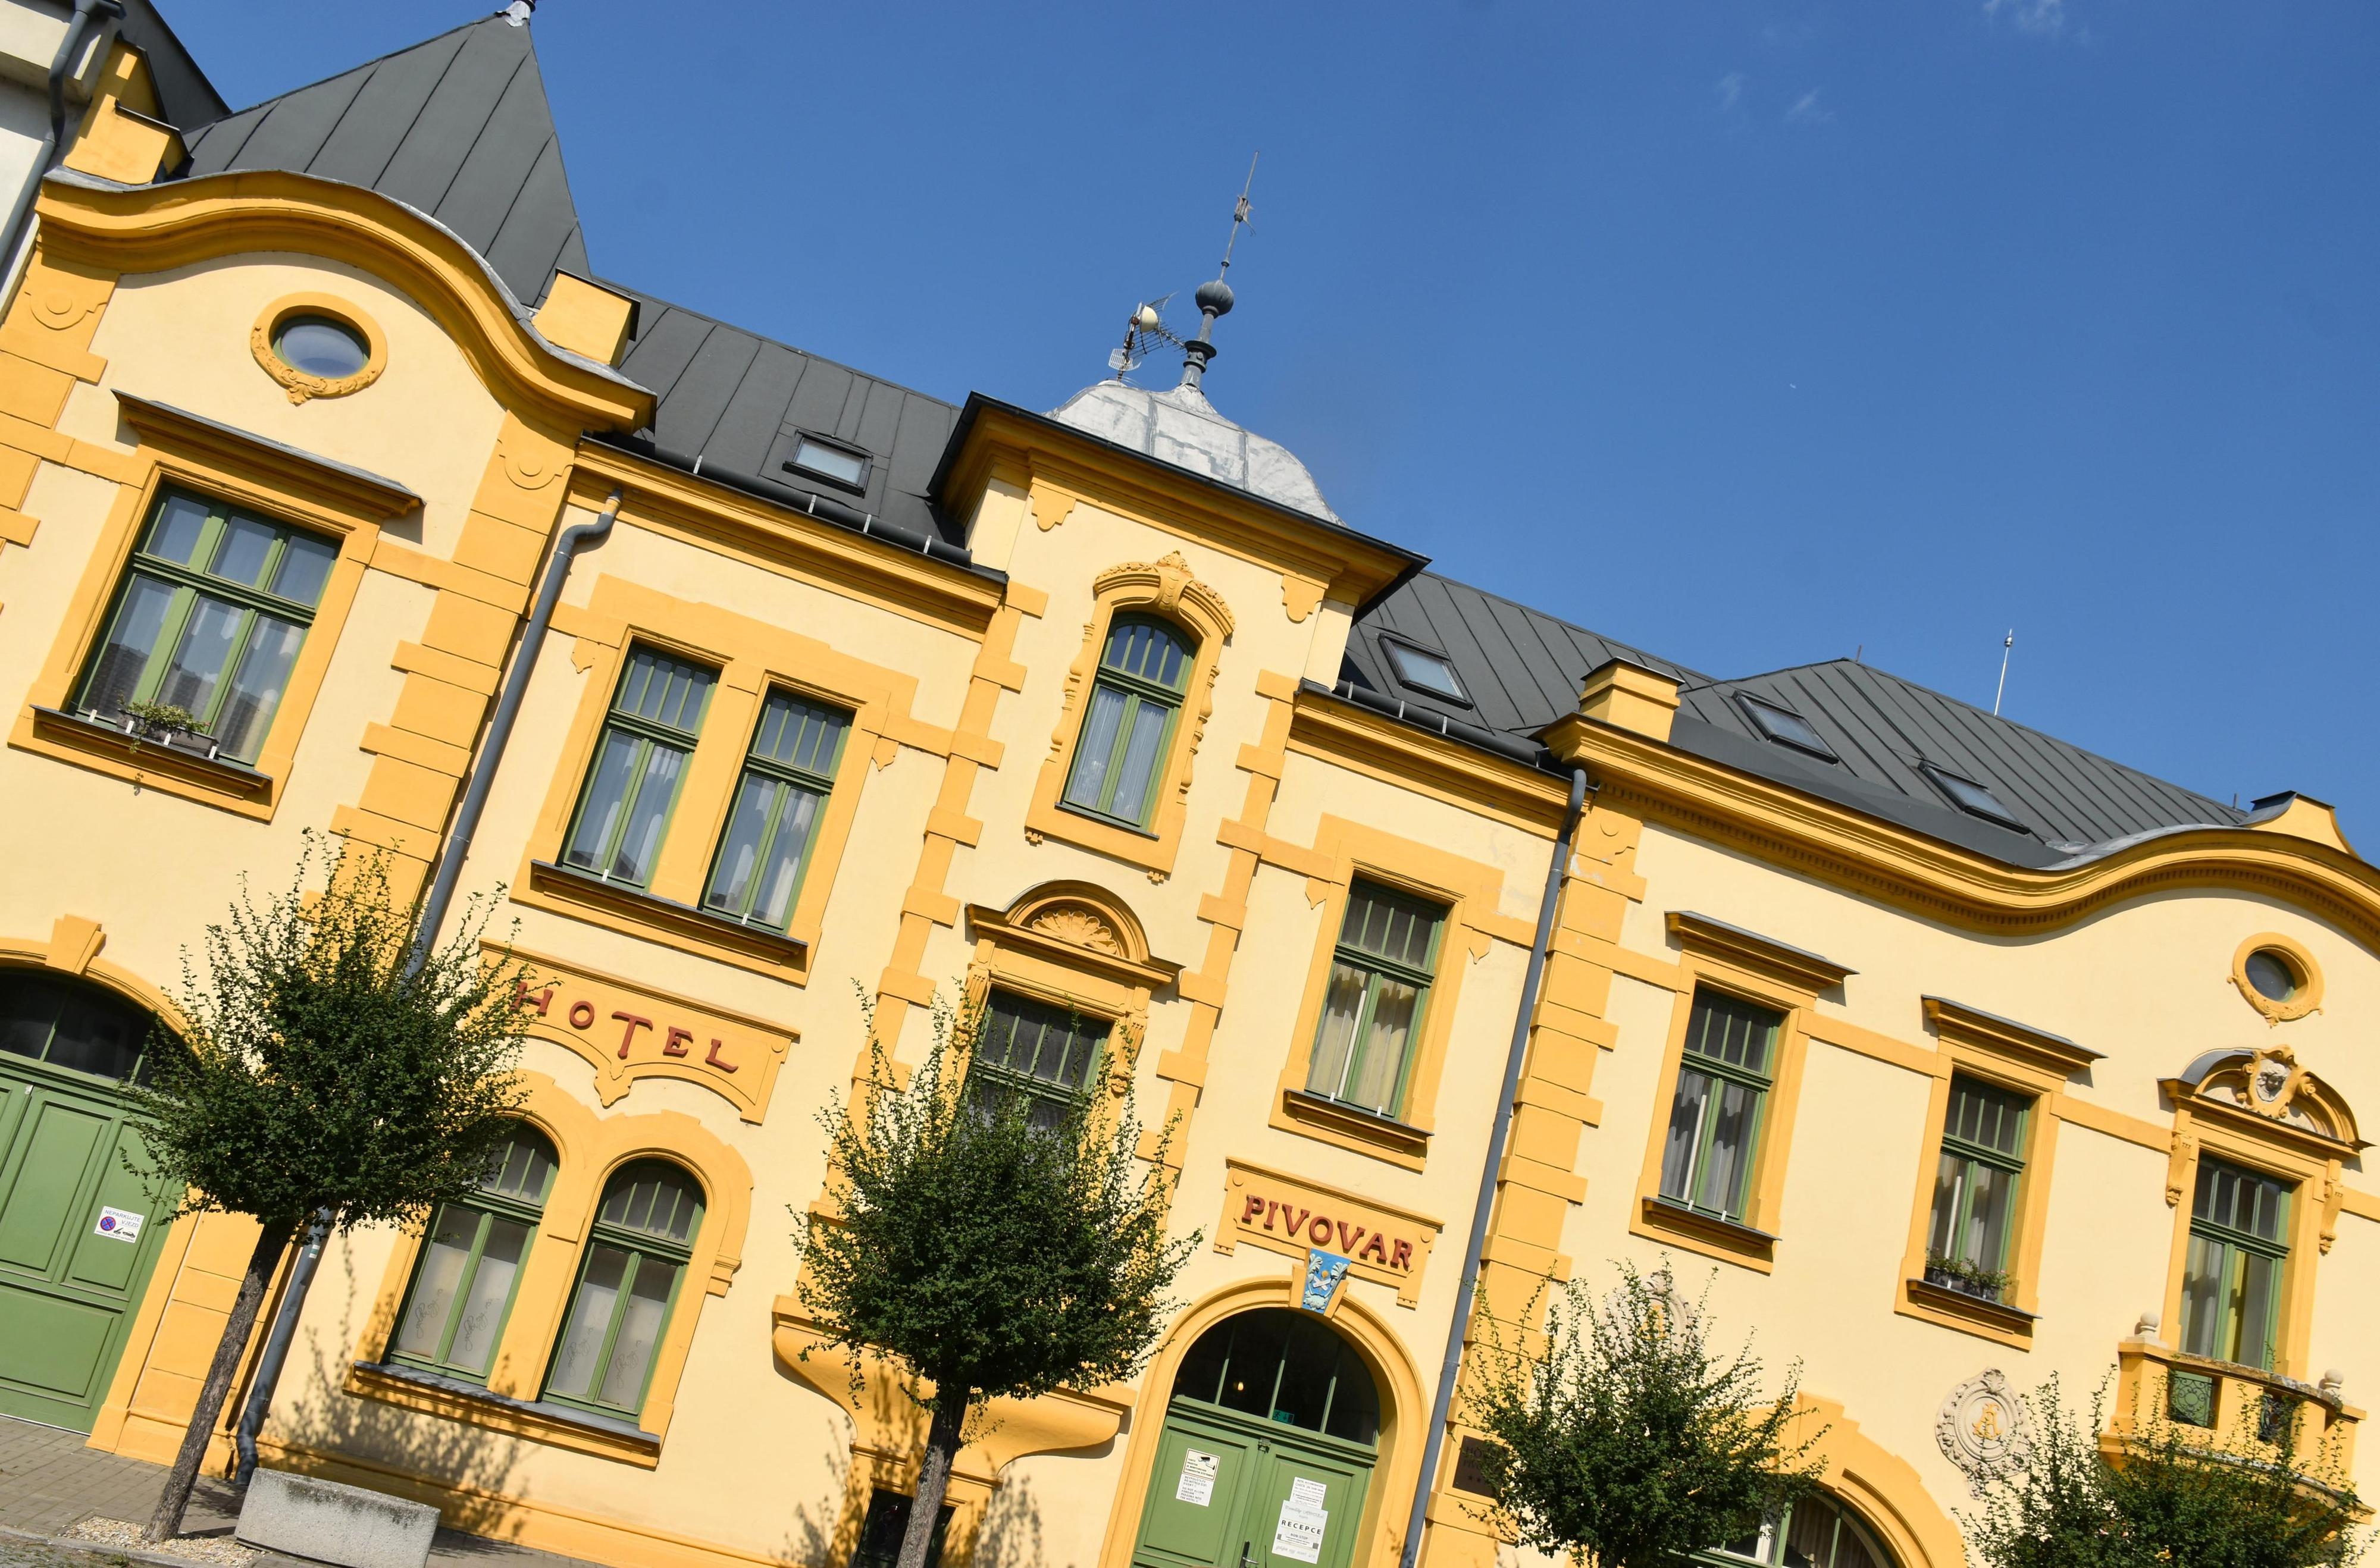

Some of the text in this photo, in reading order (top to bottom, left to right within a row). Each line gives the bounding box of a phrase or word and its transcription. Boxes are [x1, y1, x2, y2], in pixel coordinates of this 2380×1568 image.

[509, 981, 738, 1074] HOTEL
[105, 1210, 140, 1222] NEPARKUJTE
[1241, 1194, 1414, 1270] PIVOVAR
[1281, 1520, 1321, 1535] RECEPCE
